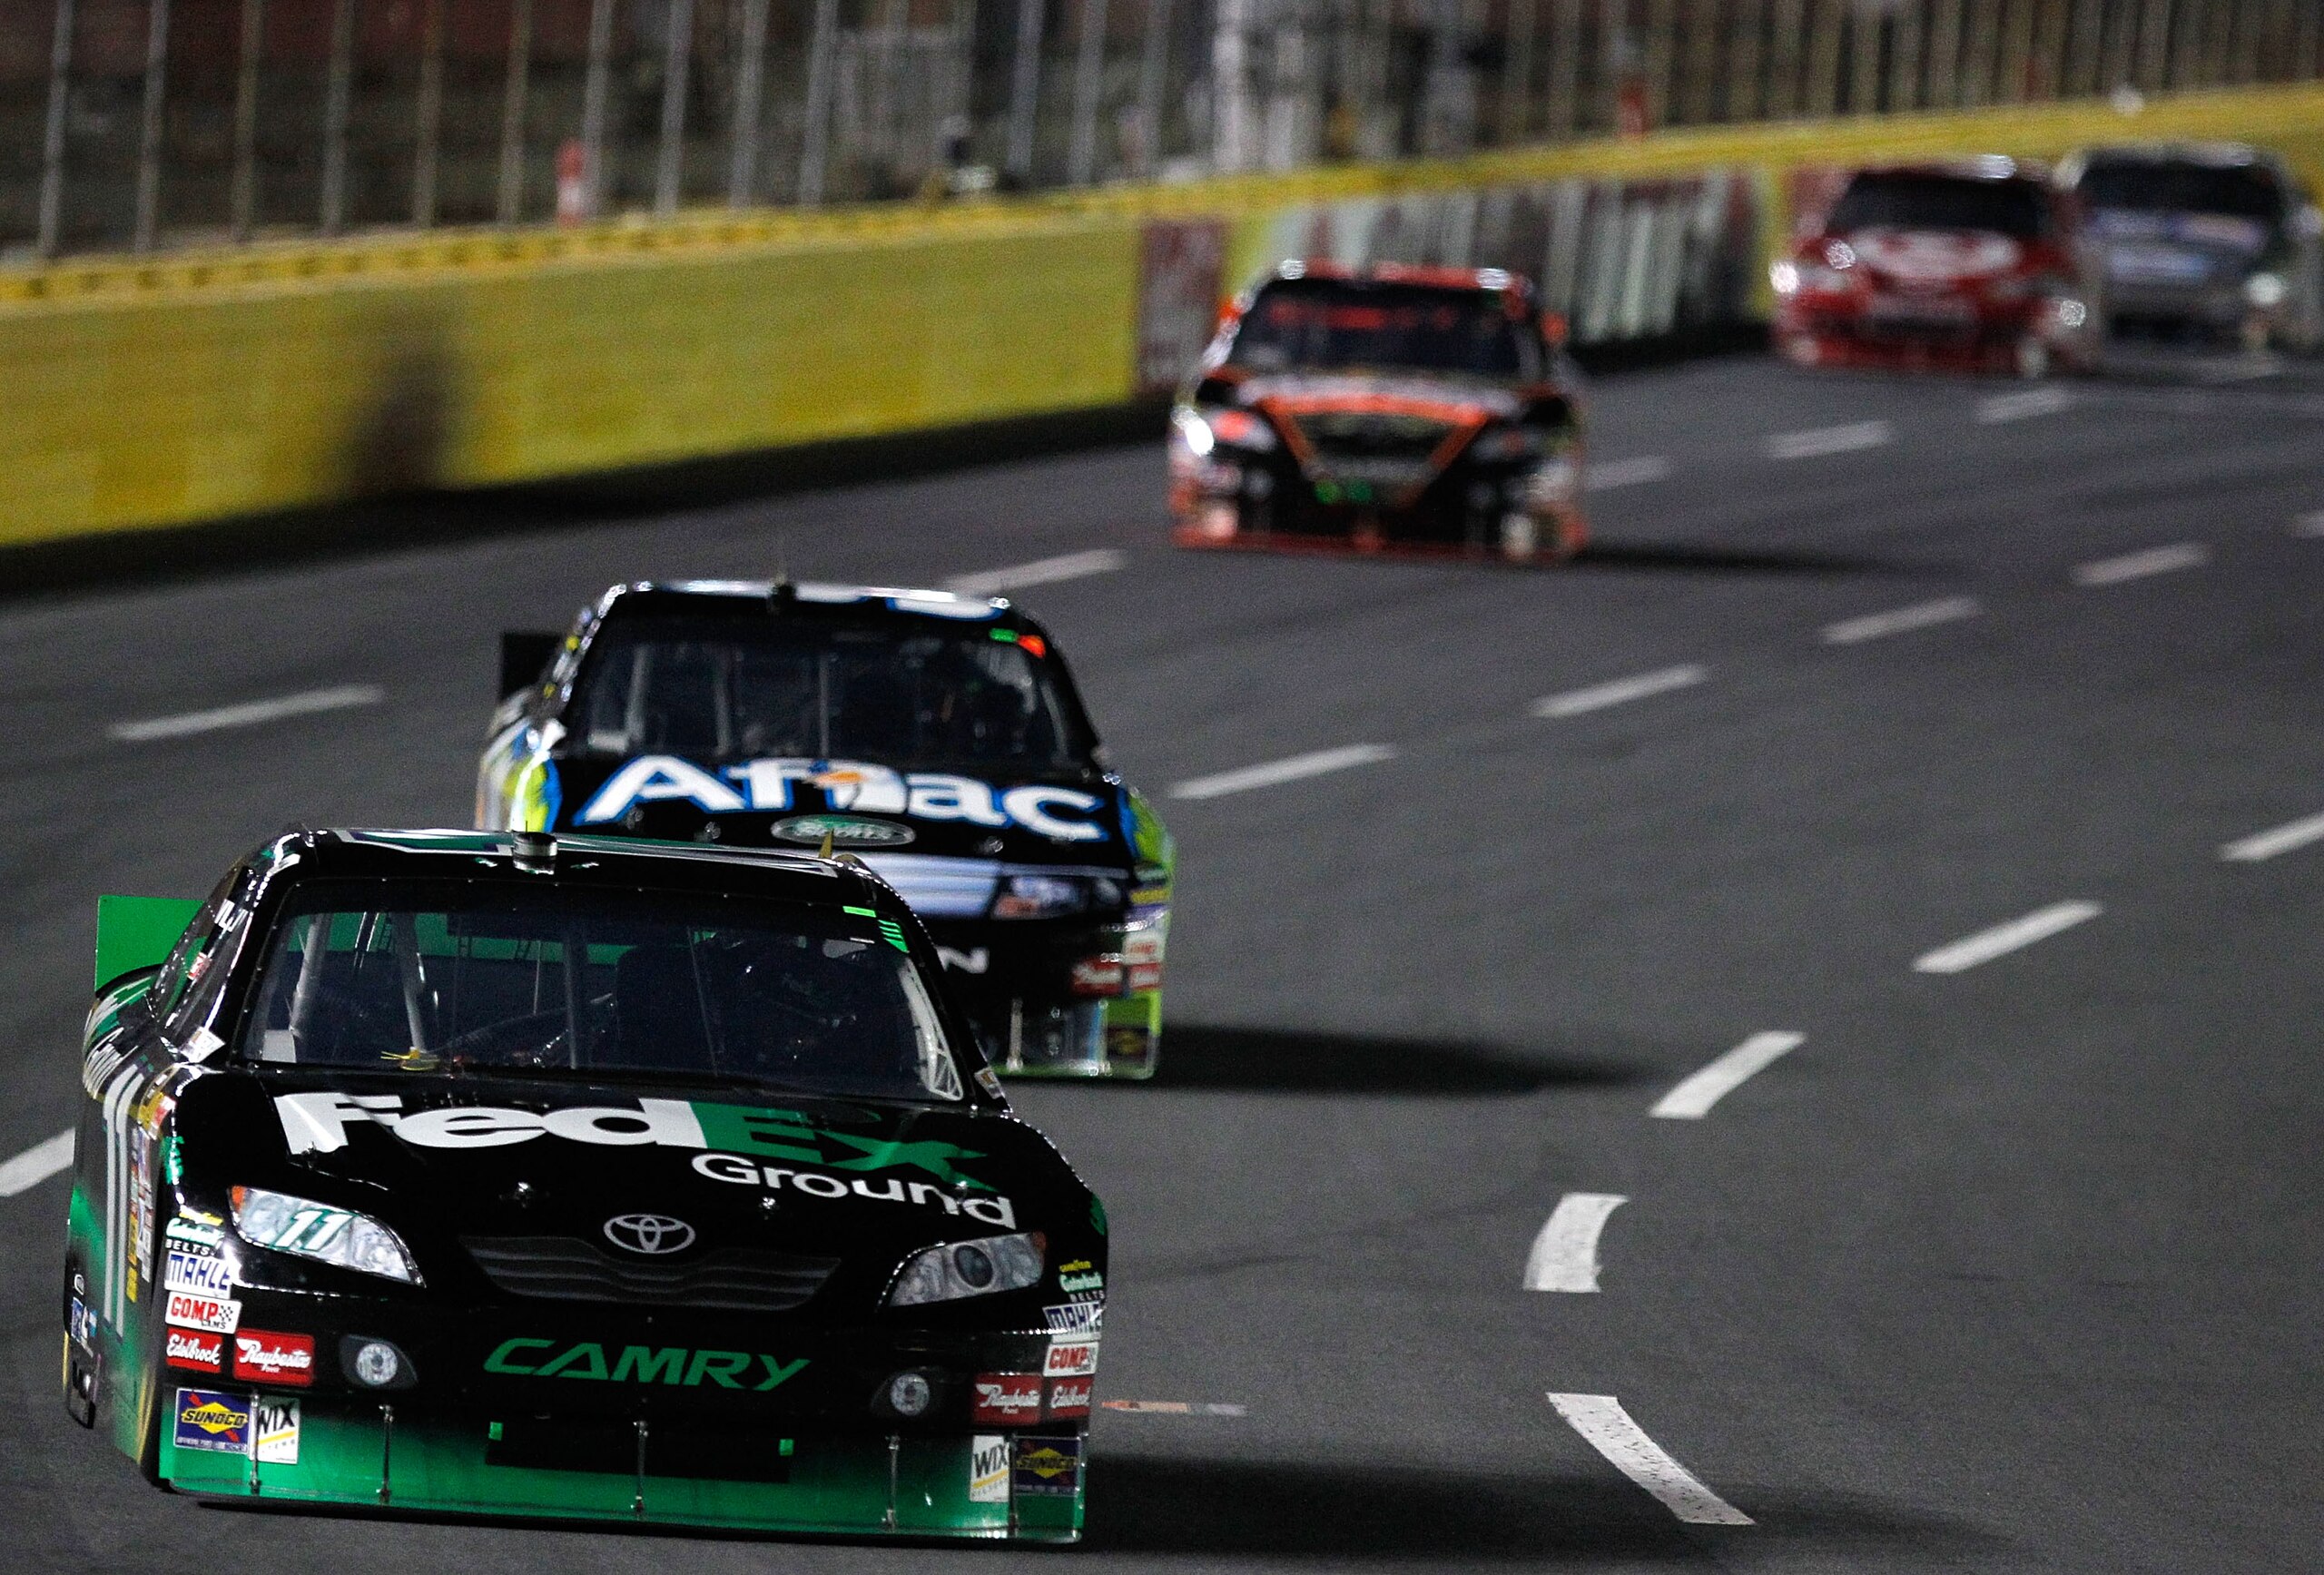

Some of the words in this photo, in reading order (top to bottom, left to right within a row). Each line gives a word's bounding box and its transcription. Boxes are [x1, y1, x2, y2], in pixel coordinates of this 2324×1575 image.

[276, 1092, 998, 1192] FedEx
[692, 1153, 1016, 1229] Ground
[165, 1238, 211, 1256] BELTS
[272, 1208, 355, 1252] 11
[171, 1296, 219, 1323] COMP
[166, 1333, 222, 1365] Edelbrock
[483, 1337, 812, 1392] CAMRY
[184, 1409, 245, 1427] SUNOCO
[973, 1443, 1009, 1479] WIX
